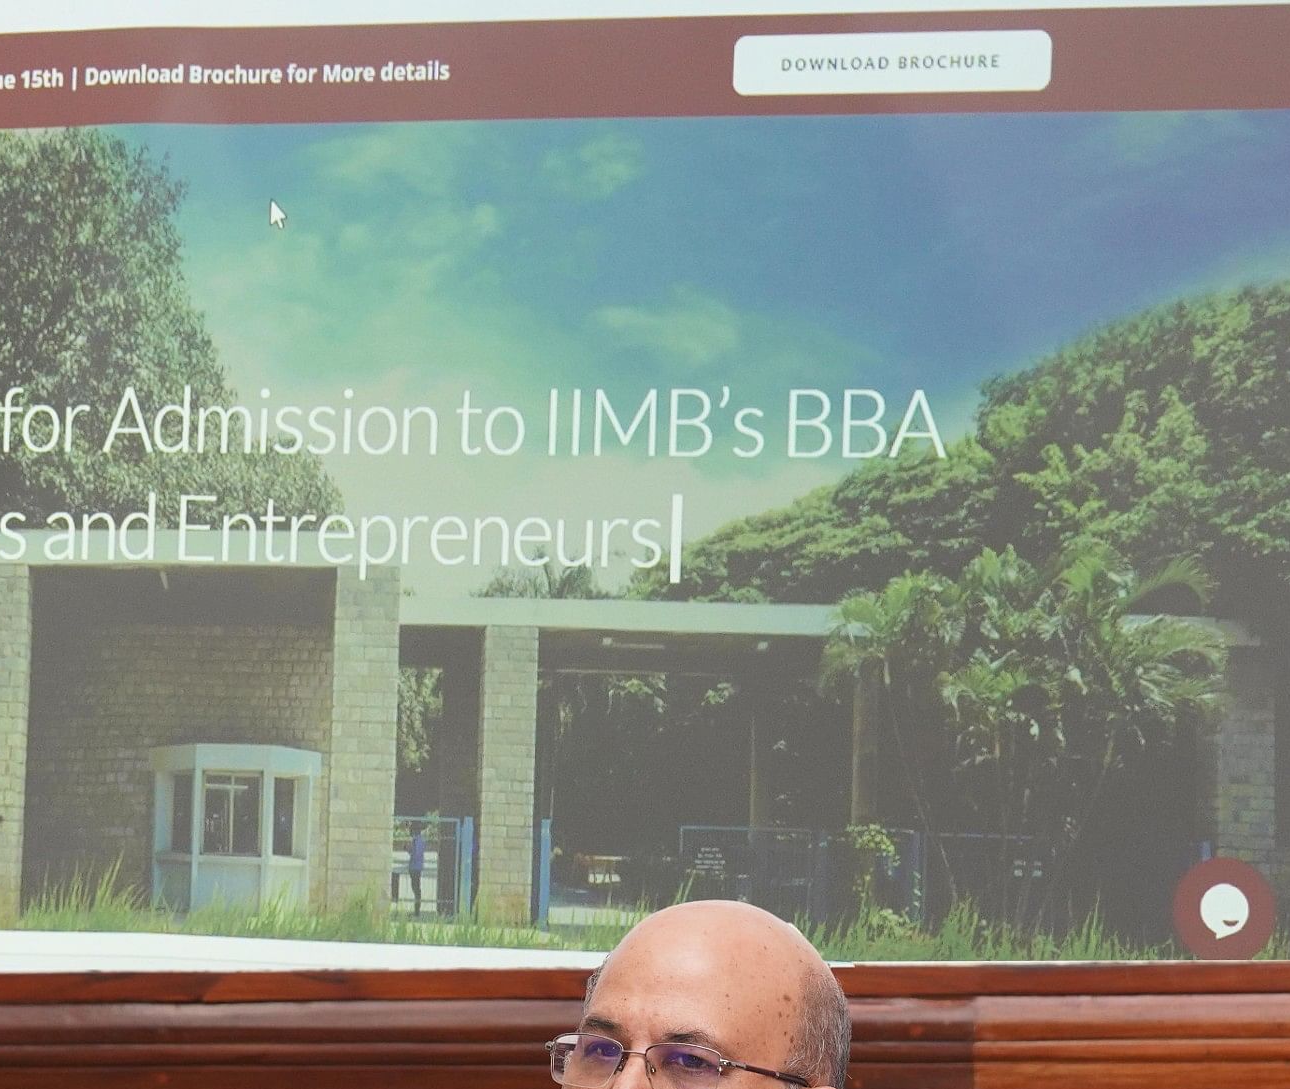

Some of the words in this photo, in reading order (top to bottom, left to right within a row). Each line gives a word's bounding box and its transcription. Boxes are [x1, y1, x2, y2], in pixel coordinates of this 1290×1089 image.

[21, 68, 64, 89] 15th
[84, 64, 183, 86] Download
[189, 64, 282, 84] Brochure
[287, 63, 317, 83] for
[323, 64, 374, 83] More
[380, 60, 450, 81] details
[781, 56, 890, 71] DOWNLOAD
[898, 54, 1001, 70] BROCHURE
[102, 384, 439, 455] Admission
[456, 390, 526, 456] to
[787, 388, 947, 458] BBA
[43, 491, 157, 561] and
